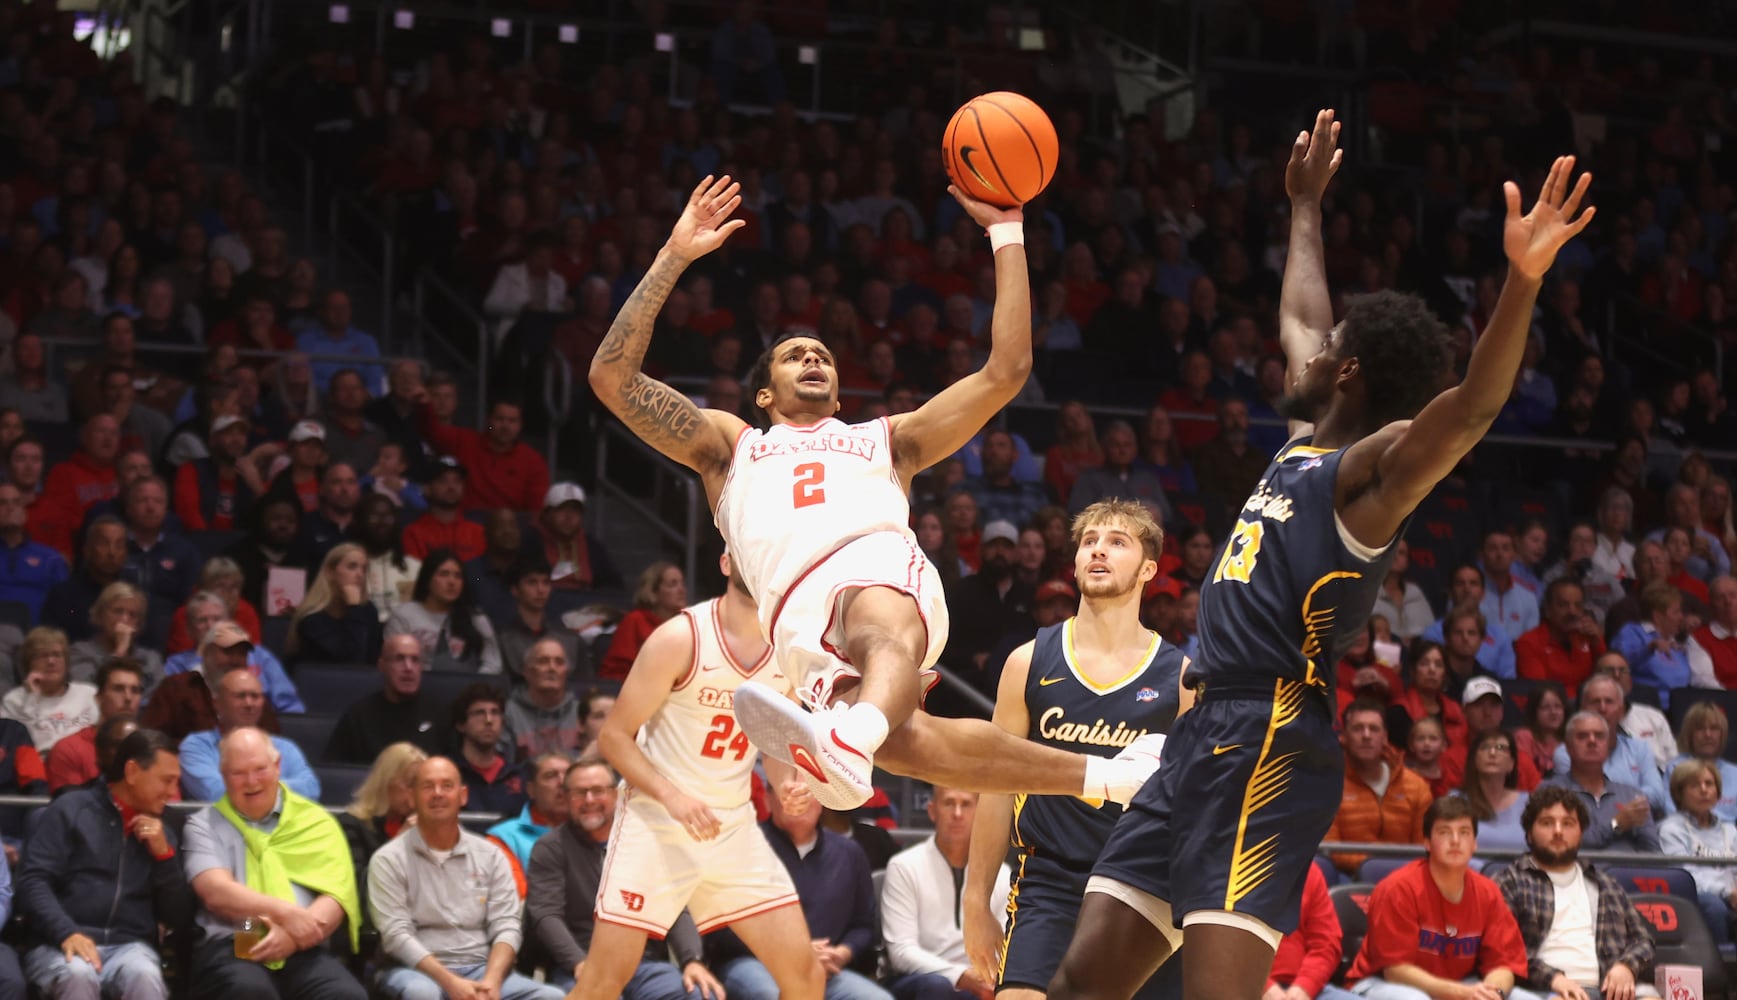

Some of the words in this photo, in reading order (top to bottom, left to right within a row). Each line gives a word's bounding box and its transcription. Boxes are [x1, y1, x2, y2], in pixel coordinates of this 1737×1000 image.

[621, 374, 700, 440] SACRIFICE
[750, 433, 875, 462] DAYTON
[793, 461, 826, 509] 2
[1213, 518, 1265, 584] 13
[700, 714, 749, 761] 24
[1039, 706, 1148, 748] Canisiu
